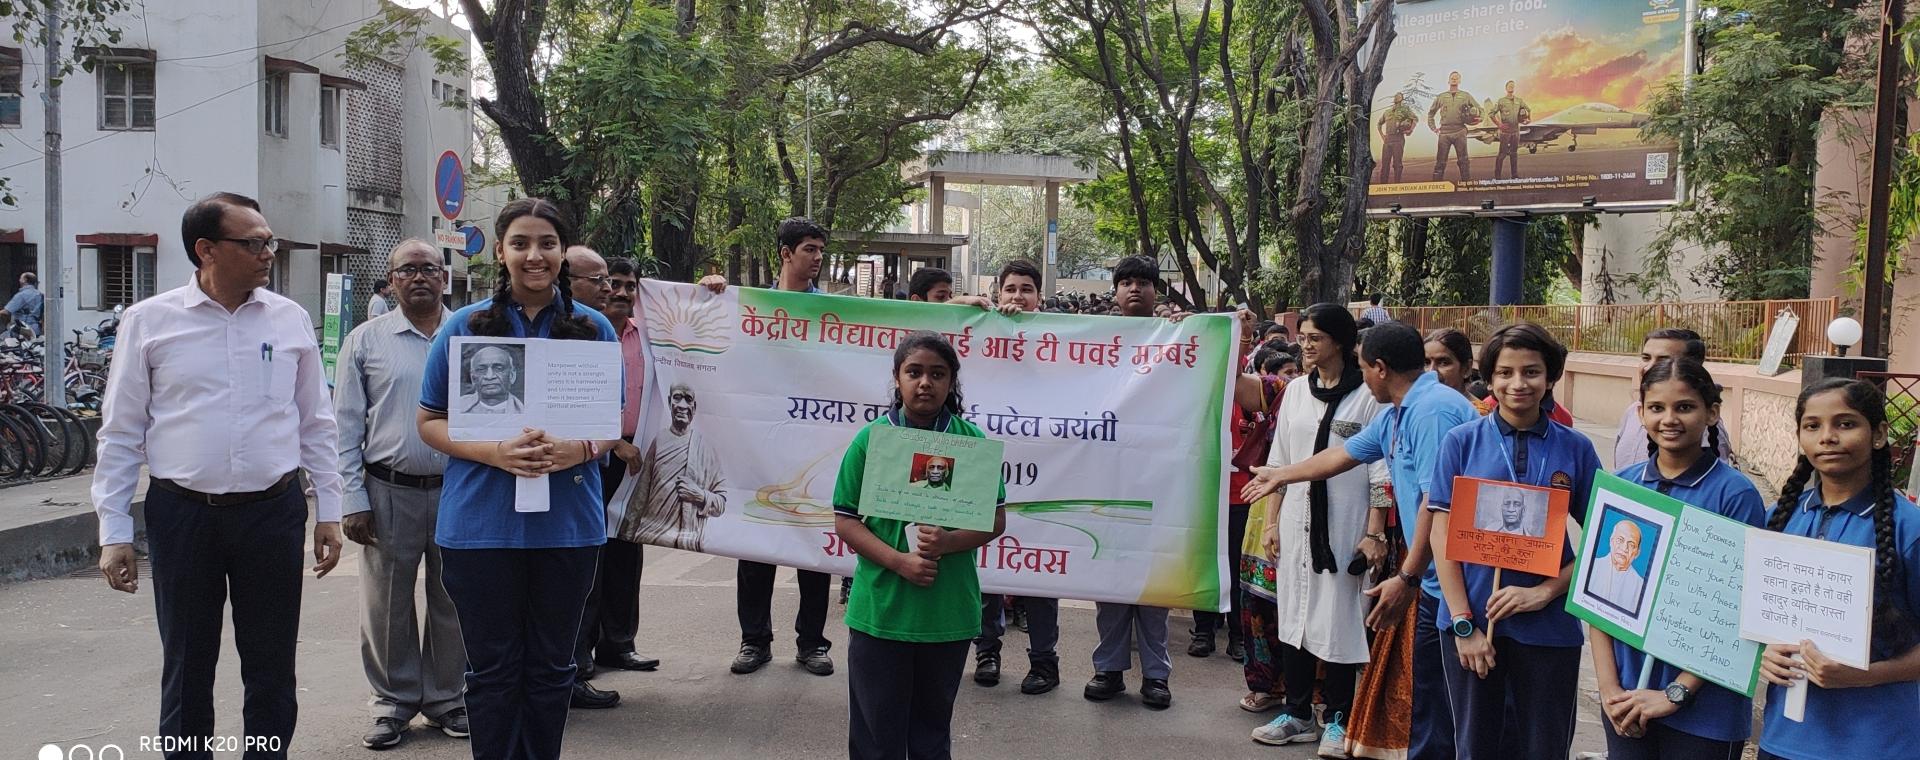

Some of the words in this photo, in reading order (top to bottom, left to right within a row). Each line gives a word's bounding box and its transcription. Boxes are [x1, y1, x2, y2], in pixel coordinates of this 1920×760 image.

[1394, 10, 1459, 27] olleagues
[1464, 3, 1505, 19] share
[1509, 0, 1547, 13] food.
[1395, 29, 1445, 48] ingmen
[1450, 23, 1490, 40] share
[1495, 19, 1529, 34] fate.
[741, 305, 811, 342] केंद्रीय
[981, 330, 1027, 363] आई
[1036, 332, 1060, 363] टी
[1068, 335, 1123, 369] पवई
[1131, 335, 1200, 375] मुम्बई
[787, 395, 857, 425] सरदार
[986, 405, 1044, 438] पटेल
[1049, 409, 1119, 442] जयंती
[1001, 460, 1038, 487] 019
[997, 535, 1071, 575] दिवस
[1763, 556, 1790, 572] कठिन
[1792, 562, 1815, 577] समय
[1817, 565, 1825, 580] में
[1827, 570, 1853, 586] कायर
[1762, 574, 1788, 589] बहाना
[1823, 585, 1834, 600] तो
[1836, 589, 1853, 605] वही
[1761, 607, 1789, 625] खोजते
[1762, 591, 1789, 610] बहादुर
[1791, 597, 1818, 614] व्यक्ति
[1820, 605, 1846, 621] रास्ता
